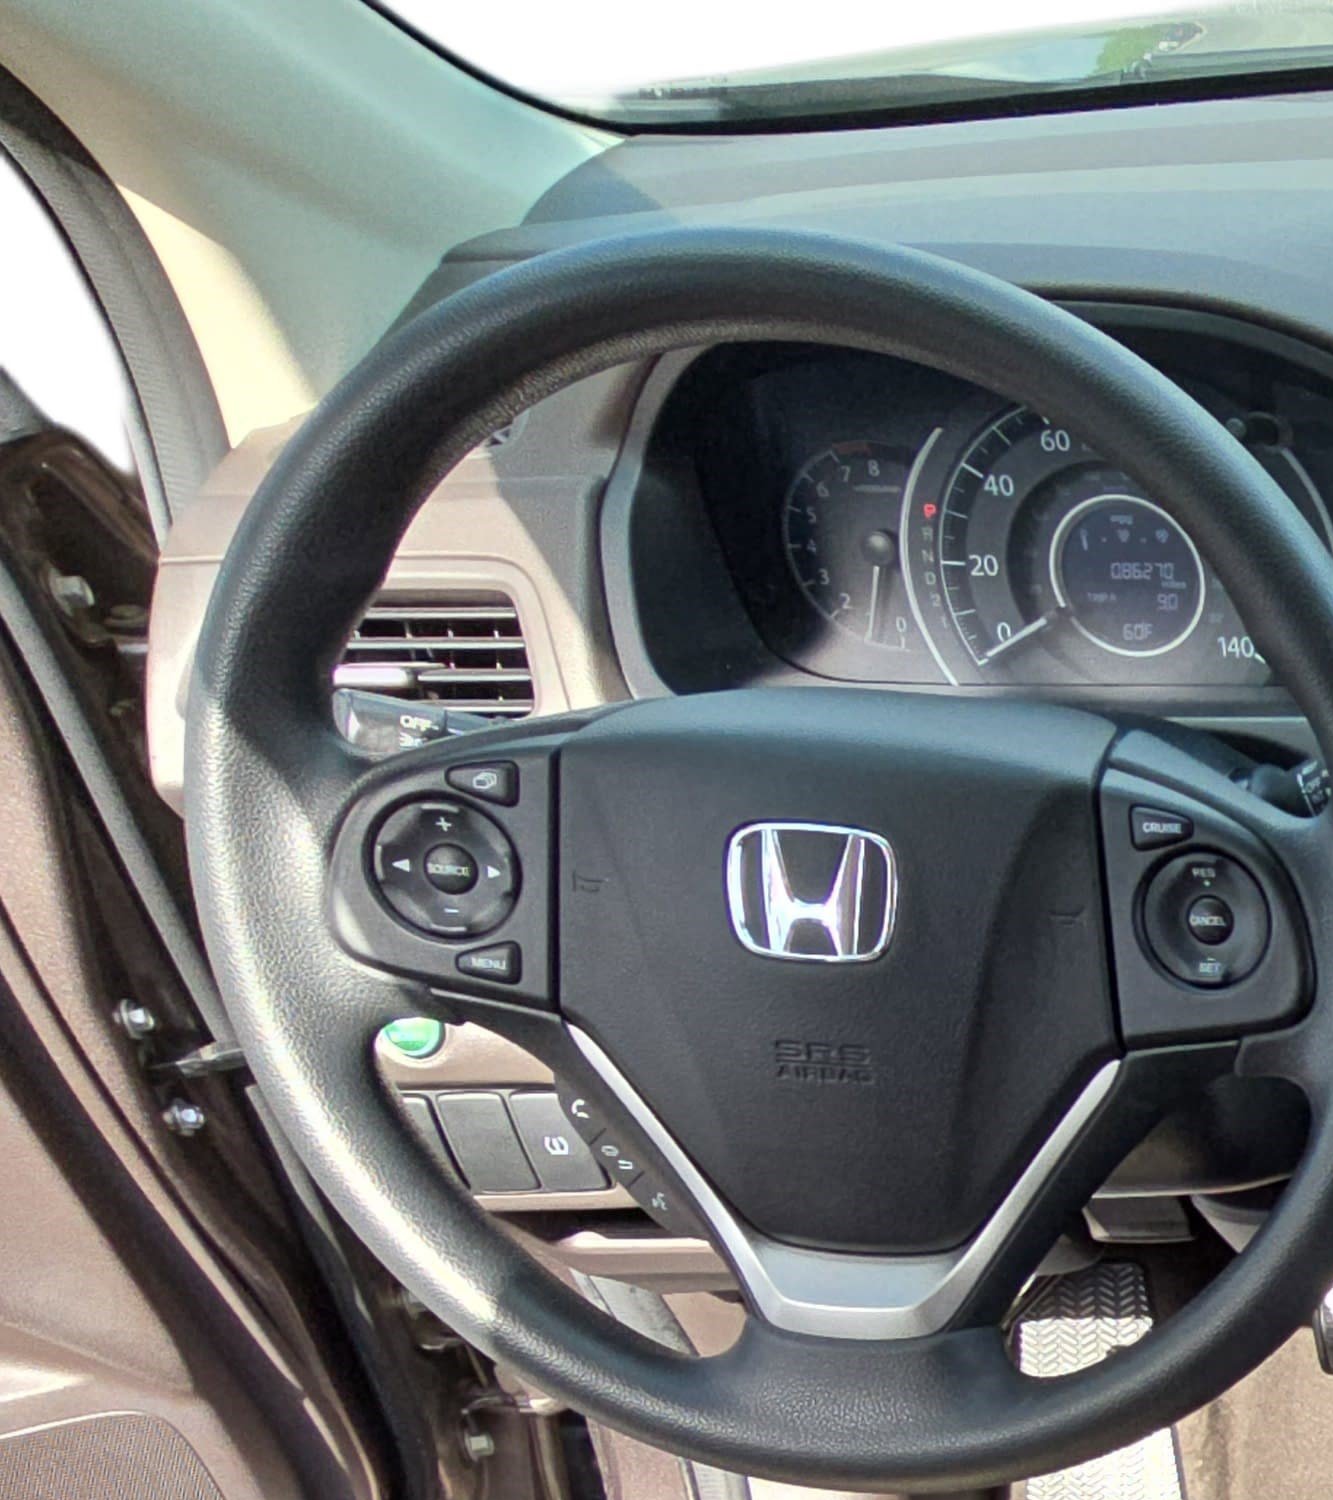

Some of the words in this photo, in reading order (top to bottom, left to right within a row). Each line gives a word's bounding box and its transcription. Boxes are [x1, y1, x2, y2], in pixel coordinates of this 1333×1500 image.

[1040, 430, 1071, 452] 60
[983, 474, 1014, 497] 40
[968, 554, 999, 577] 20
[1217, 636, 1255, 659] 140
[1142, 821, 1183, 834] CRUISE
